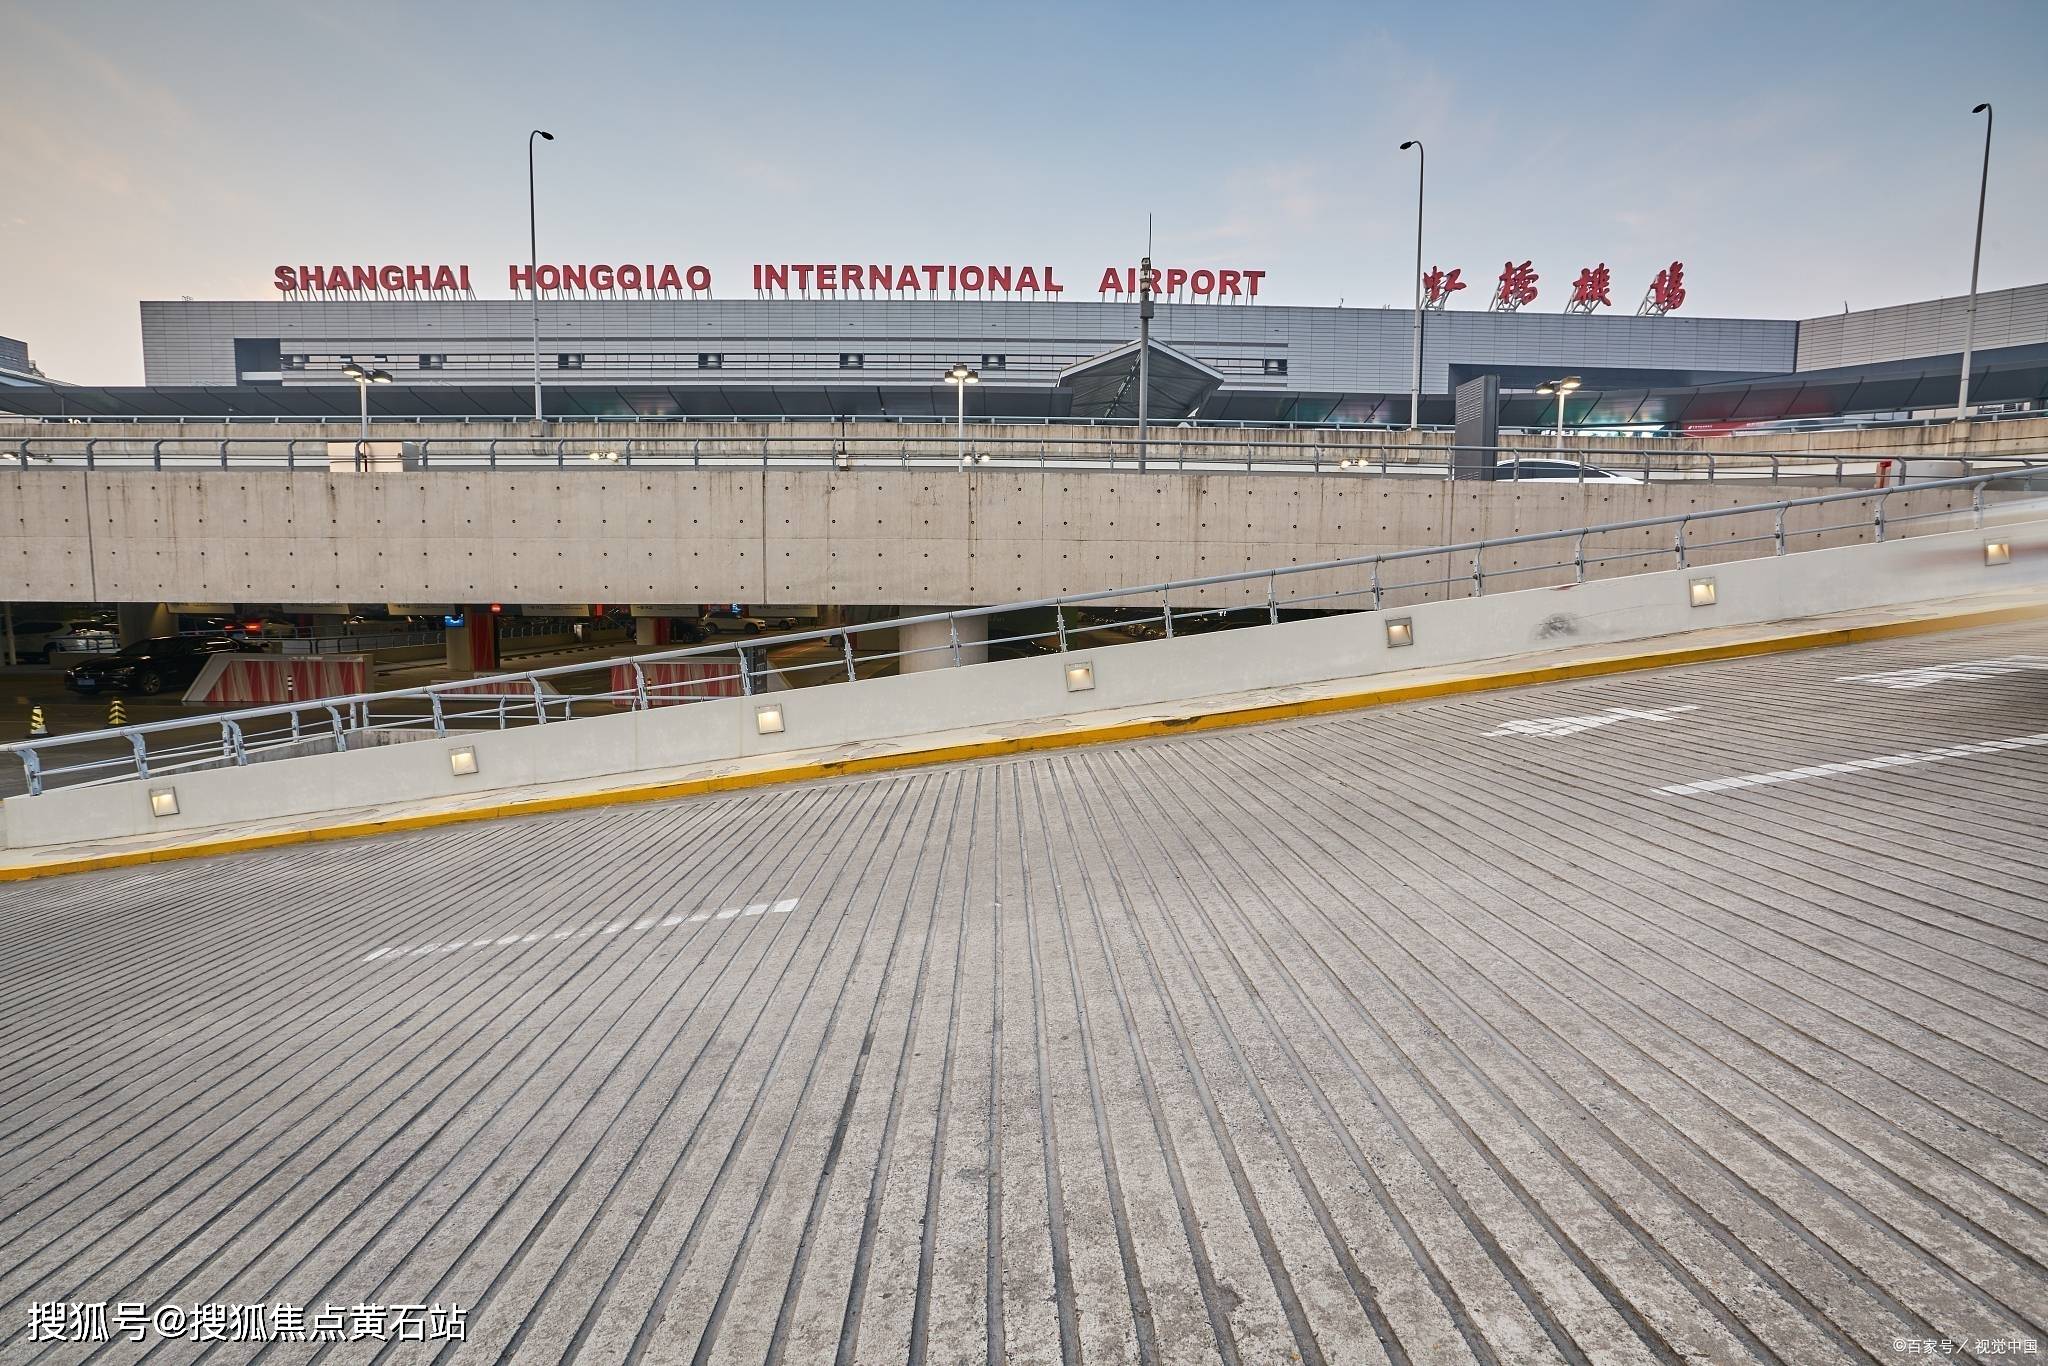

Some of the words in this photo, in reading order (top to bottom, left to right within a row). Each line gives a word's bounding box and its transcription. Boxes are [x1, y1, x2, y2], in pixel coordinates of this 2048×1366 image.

[274, 265, 469, 291] SHANGHAI
[509, 264, 711, 291] HONGQIAO
[753, 264, 1064, 292] INTERNATIONAL
[1098, 267, 1266, 296] AIRPORT
